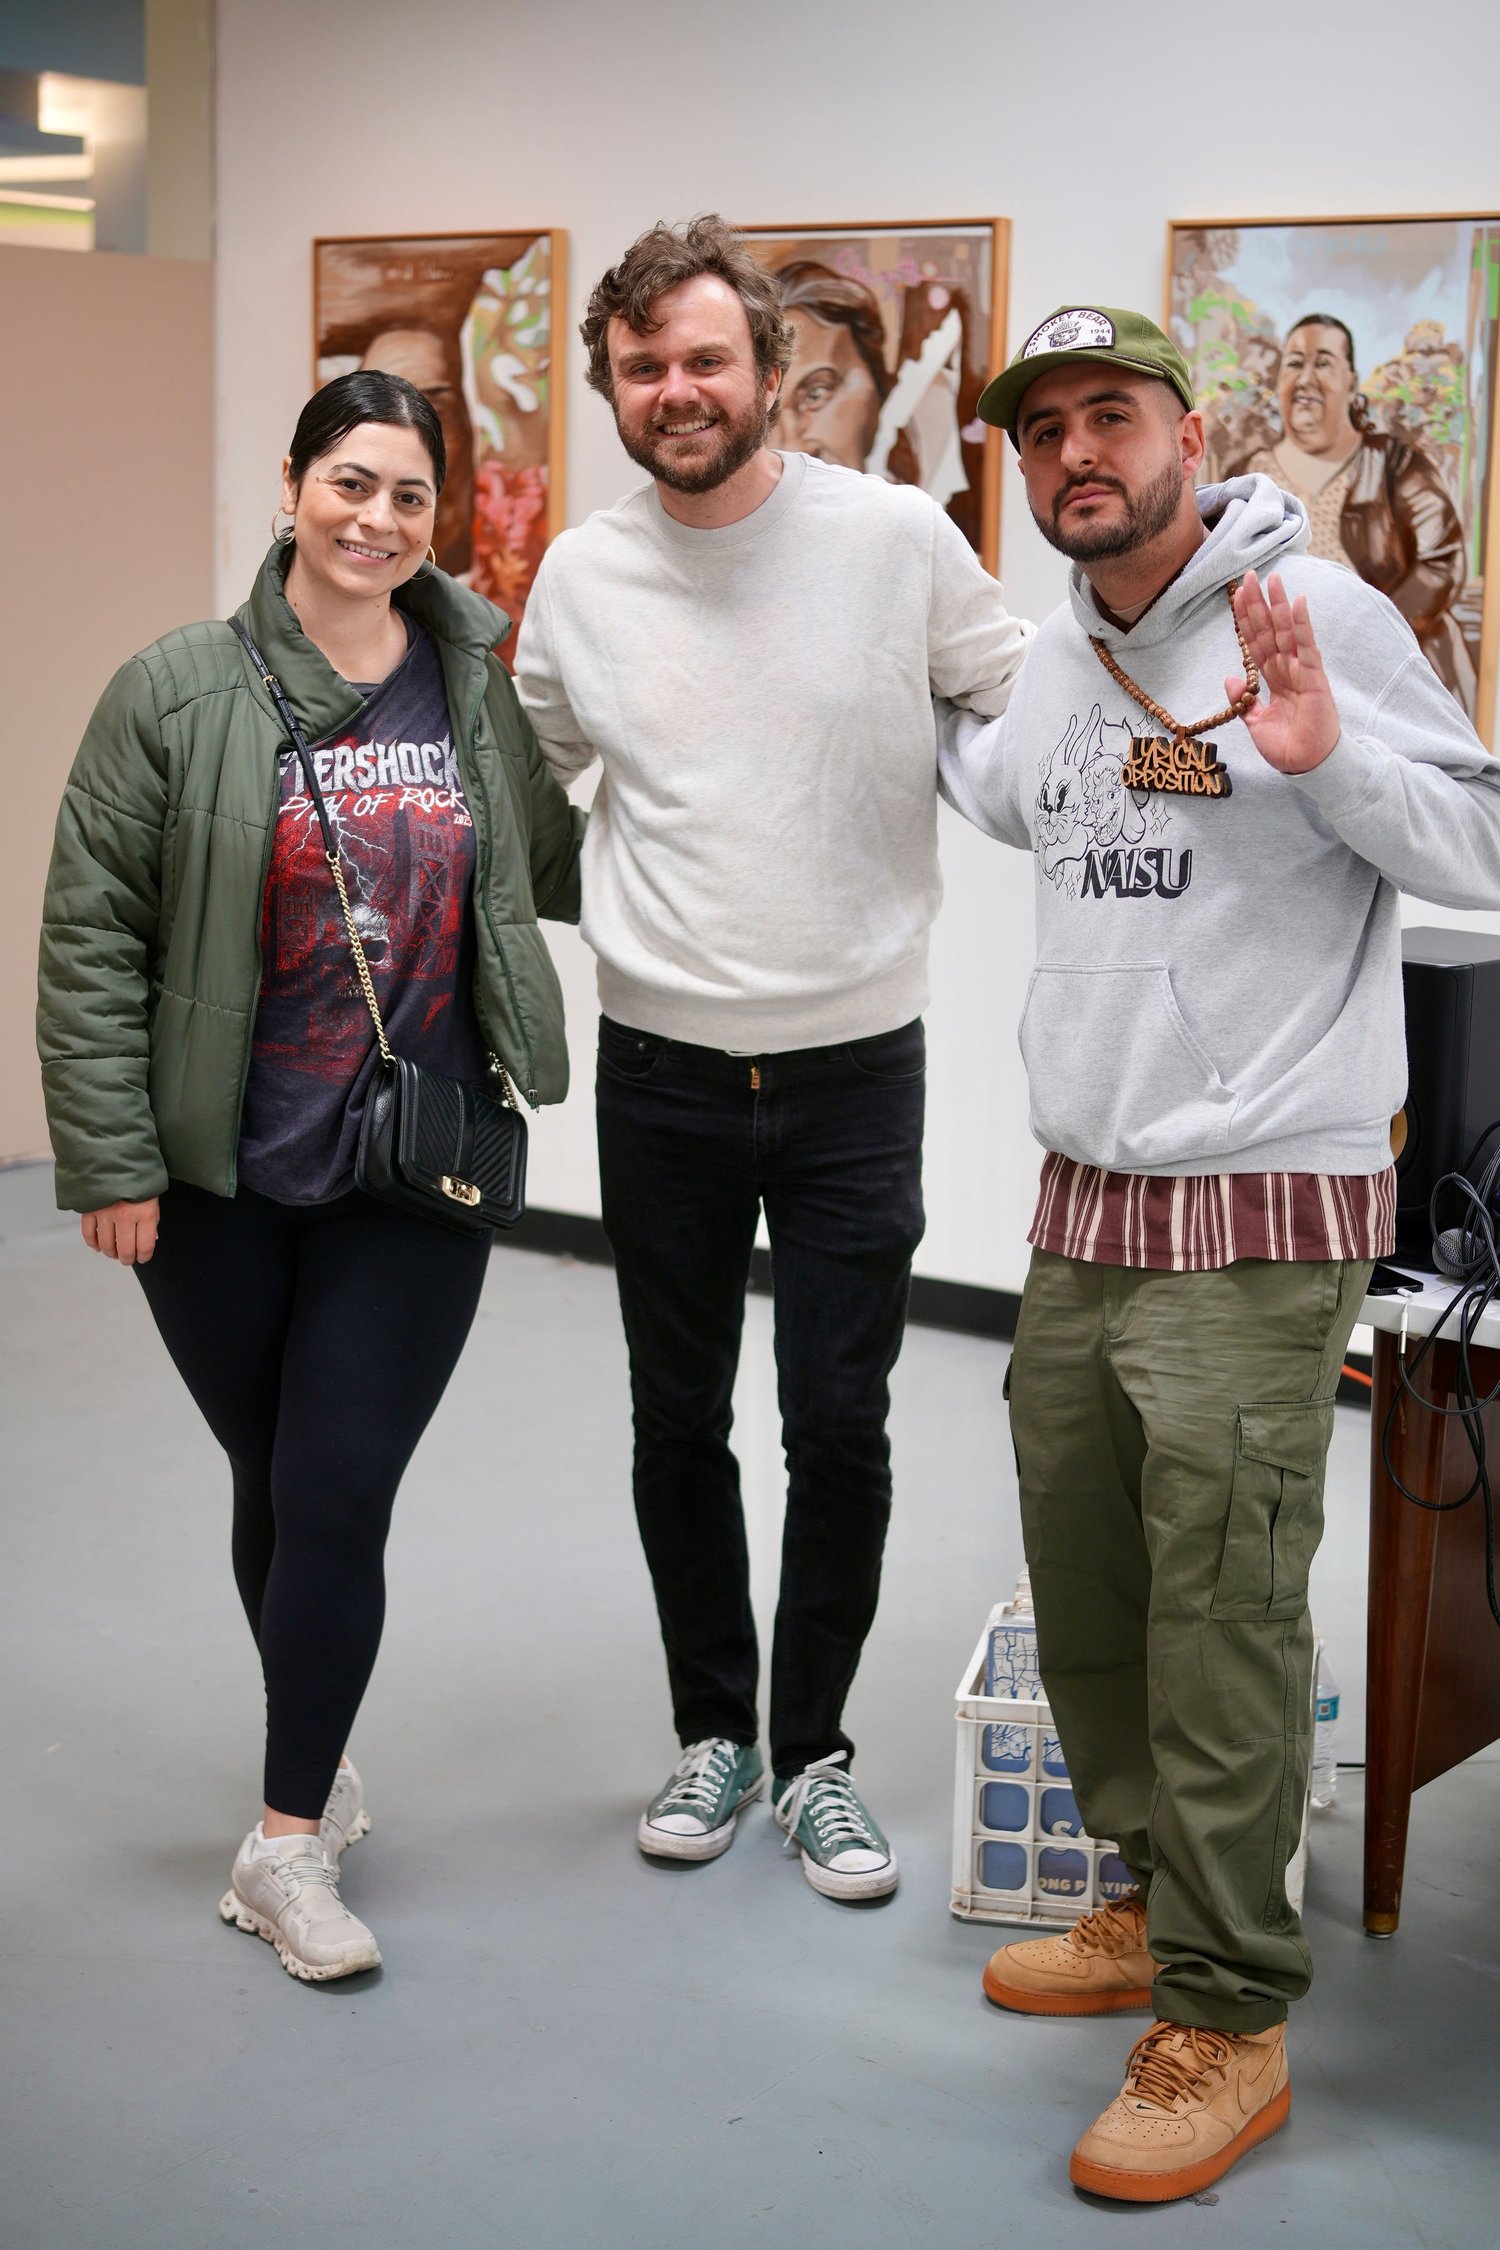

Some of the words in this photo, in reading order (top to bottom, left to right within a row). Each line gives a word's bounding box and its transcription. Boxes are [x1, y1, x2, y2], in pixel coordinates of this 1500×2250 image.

[1029, 313, 1074, 347] SMOKEY
[1078, 311, 1107, 327] BEAR
[1129, 739, 1217, 772] LYRICAL
[1121, 767, 1221, 795] OPPOSITION
[352, 793, 394, 817] OF
[398, 787, 471, 816] ROCK
[1080, 847, 1193, 899] NAISU
[1038, 1877, 1072, 1892] ONG
